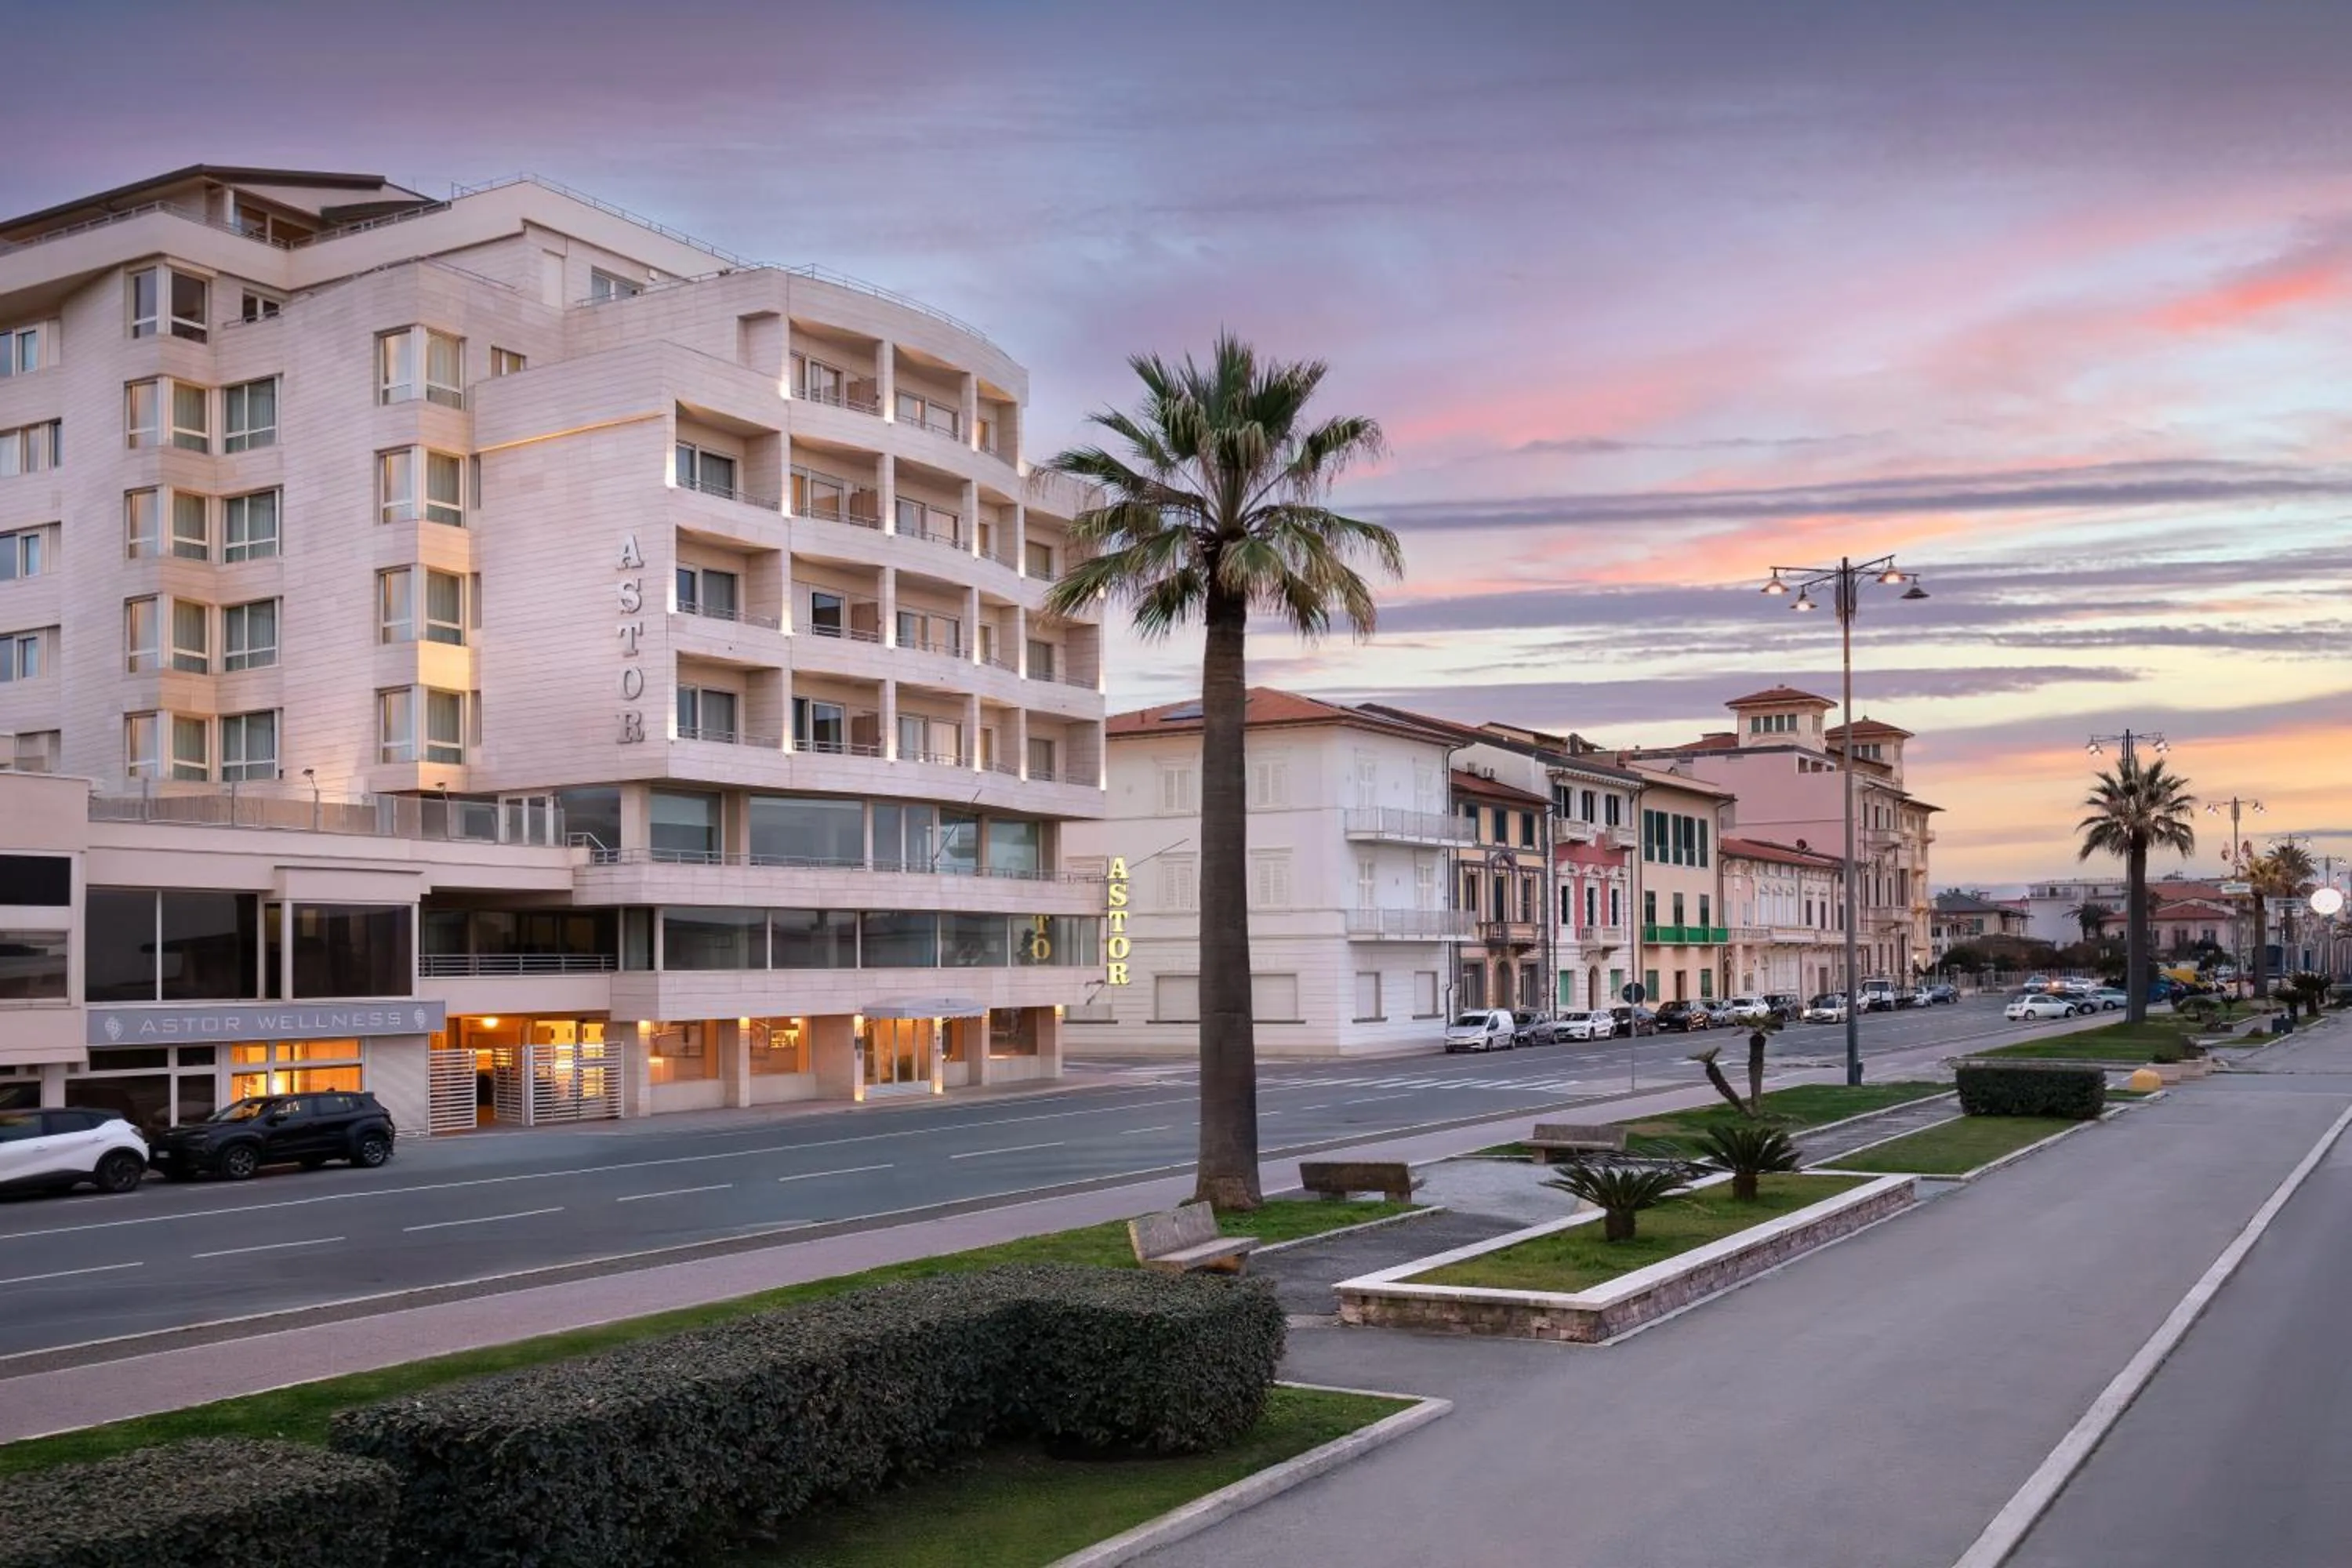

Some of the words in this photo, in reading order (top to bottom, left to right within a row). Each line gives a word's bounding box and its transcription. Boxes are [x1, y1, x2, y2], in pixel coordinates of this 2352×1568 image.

[615, 531, 645, 746] ASTOR
[1107, 857, 1131, 985] ASTOR
[139, 1018, 240, 1034] ASTOR
[256, 1011, 401, 1029] WELLNESS
